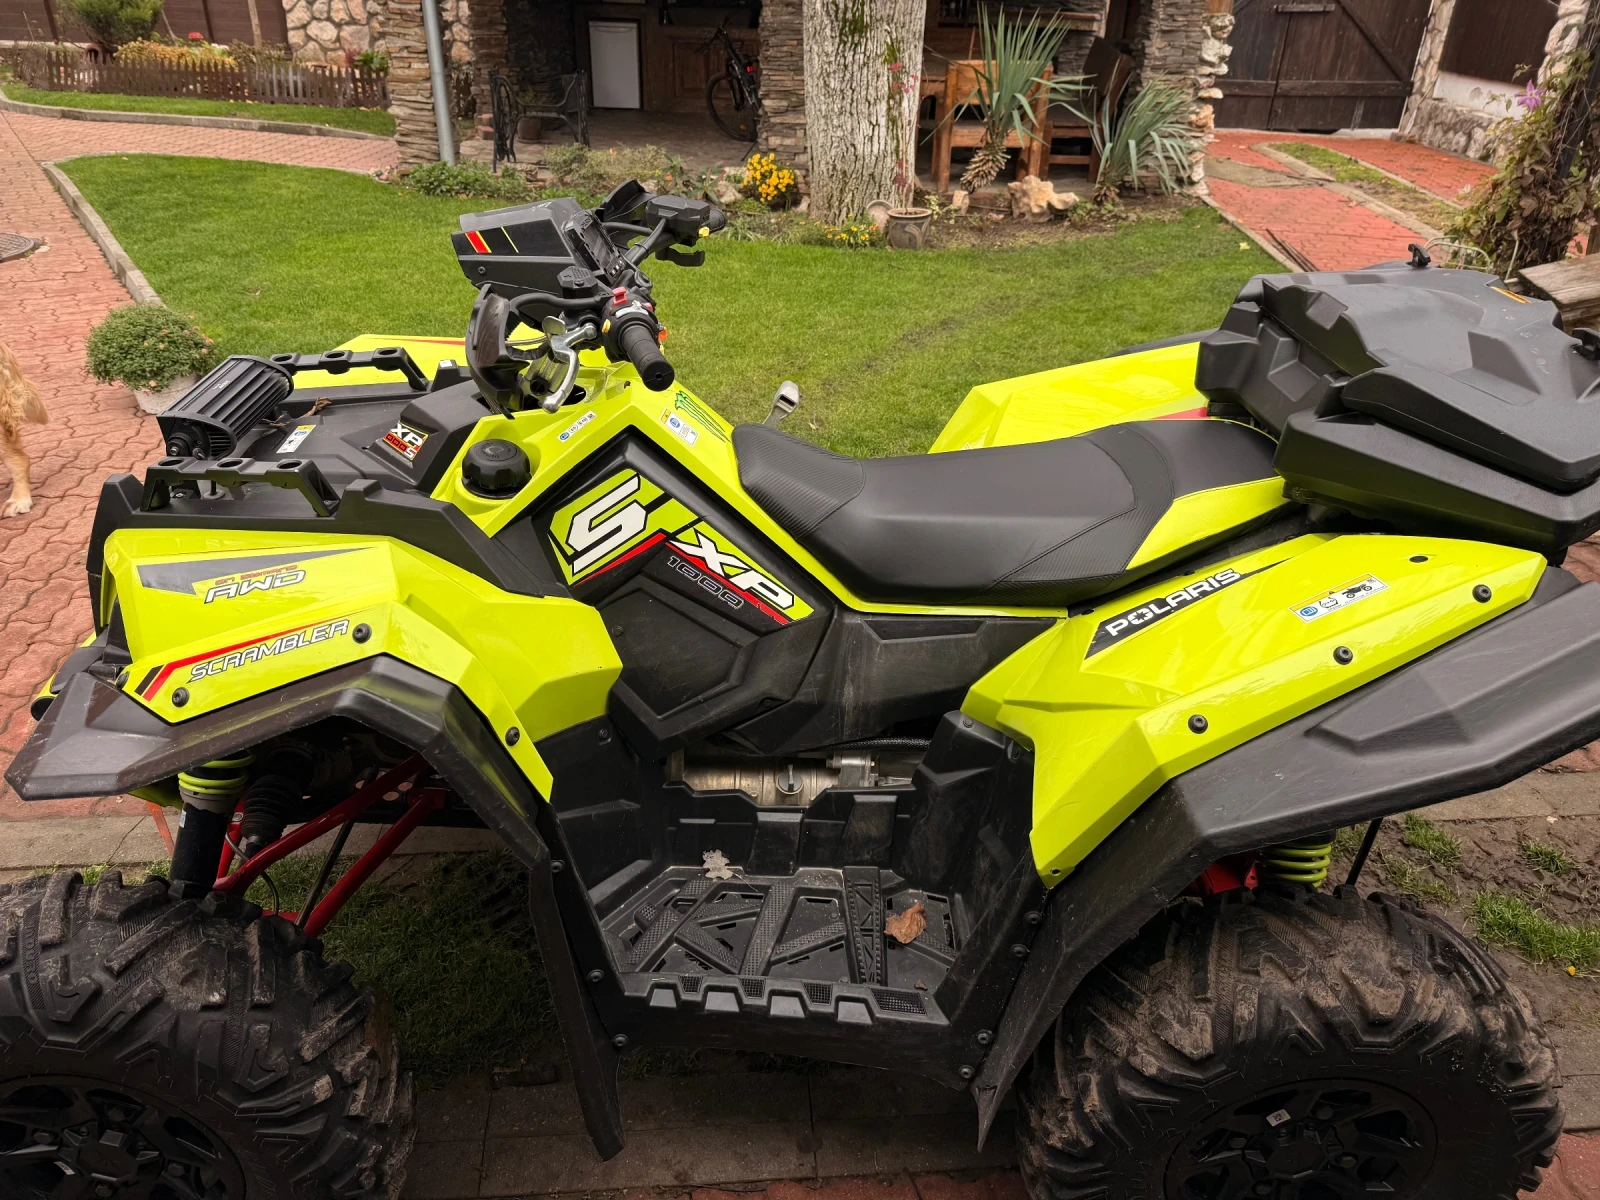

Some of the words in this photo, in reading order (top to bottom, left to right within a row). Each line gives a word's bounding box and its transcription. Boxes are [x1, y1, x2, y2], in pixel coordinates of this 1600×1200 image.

[390, 423, 423, 447] XP
[565, 473, 648, 577] S
[204, 569, 306, 604] AWD
[666, 527, 794, 611] XP
[667, 556, 744, 609] 1000
[1105, 568, 1241, 636] POLARIS
[187, 618, 350, 684] SCRAMBLER
